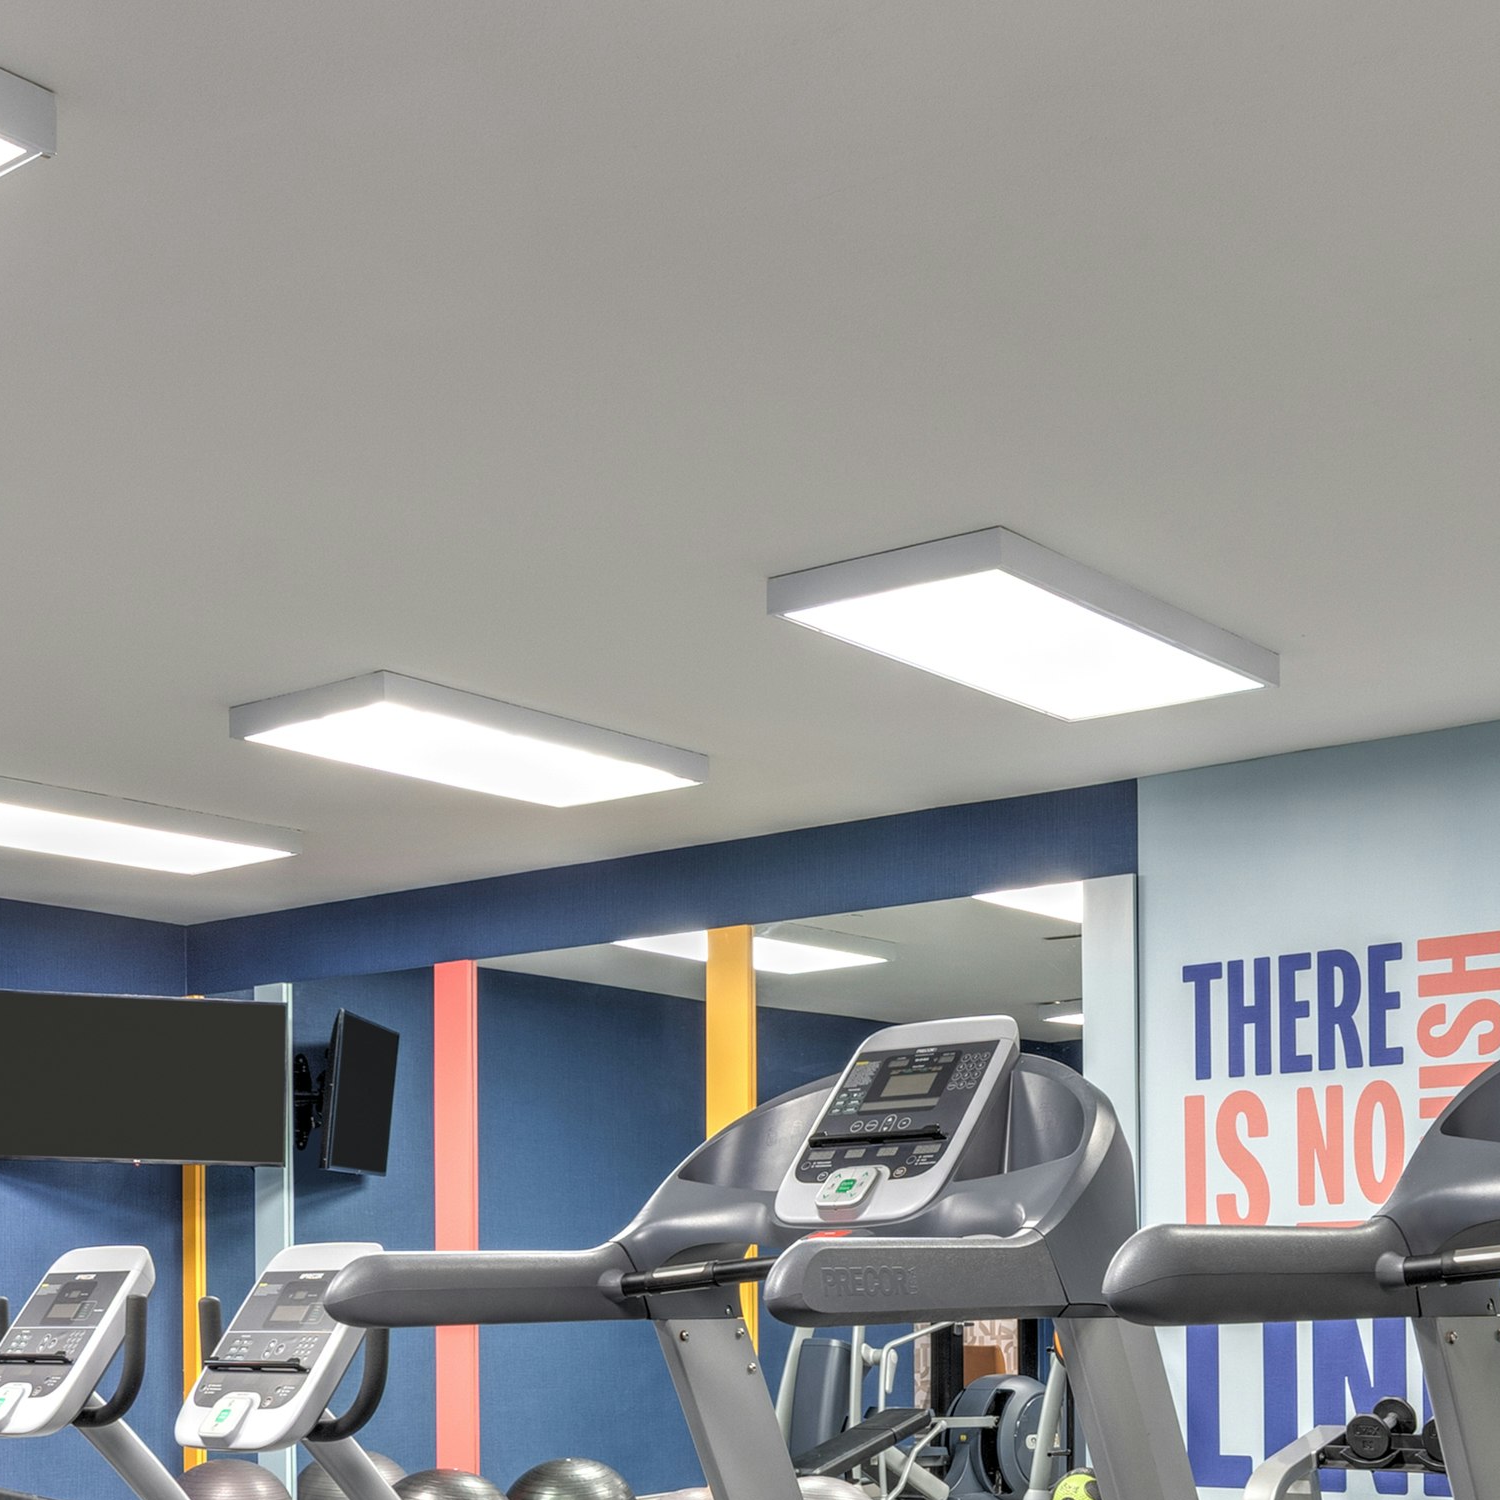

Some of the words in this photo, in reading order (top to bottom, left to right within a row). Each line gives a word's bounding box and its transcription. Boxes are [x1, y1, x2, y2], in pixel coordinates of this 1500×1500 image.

[1182, 942, 1403, 1081] THERE
[1184, 1090, 1271, 1226] IS
[1297, 1080, 1404, 1206] NO
[821, 1265, 908, 1297] PRECOR
